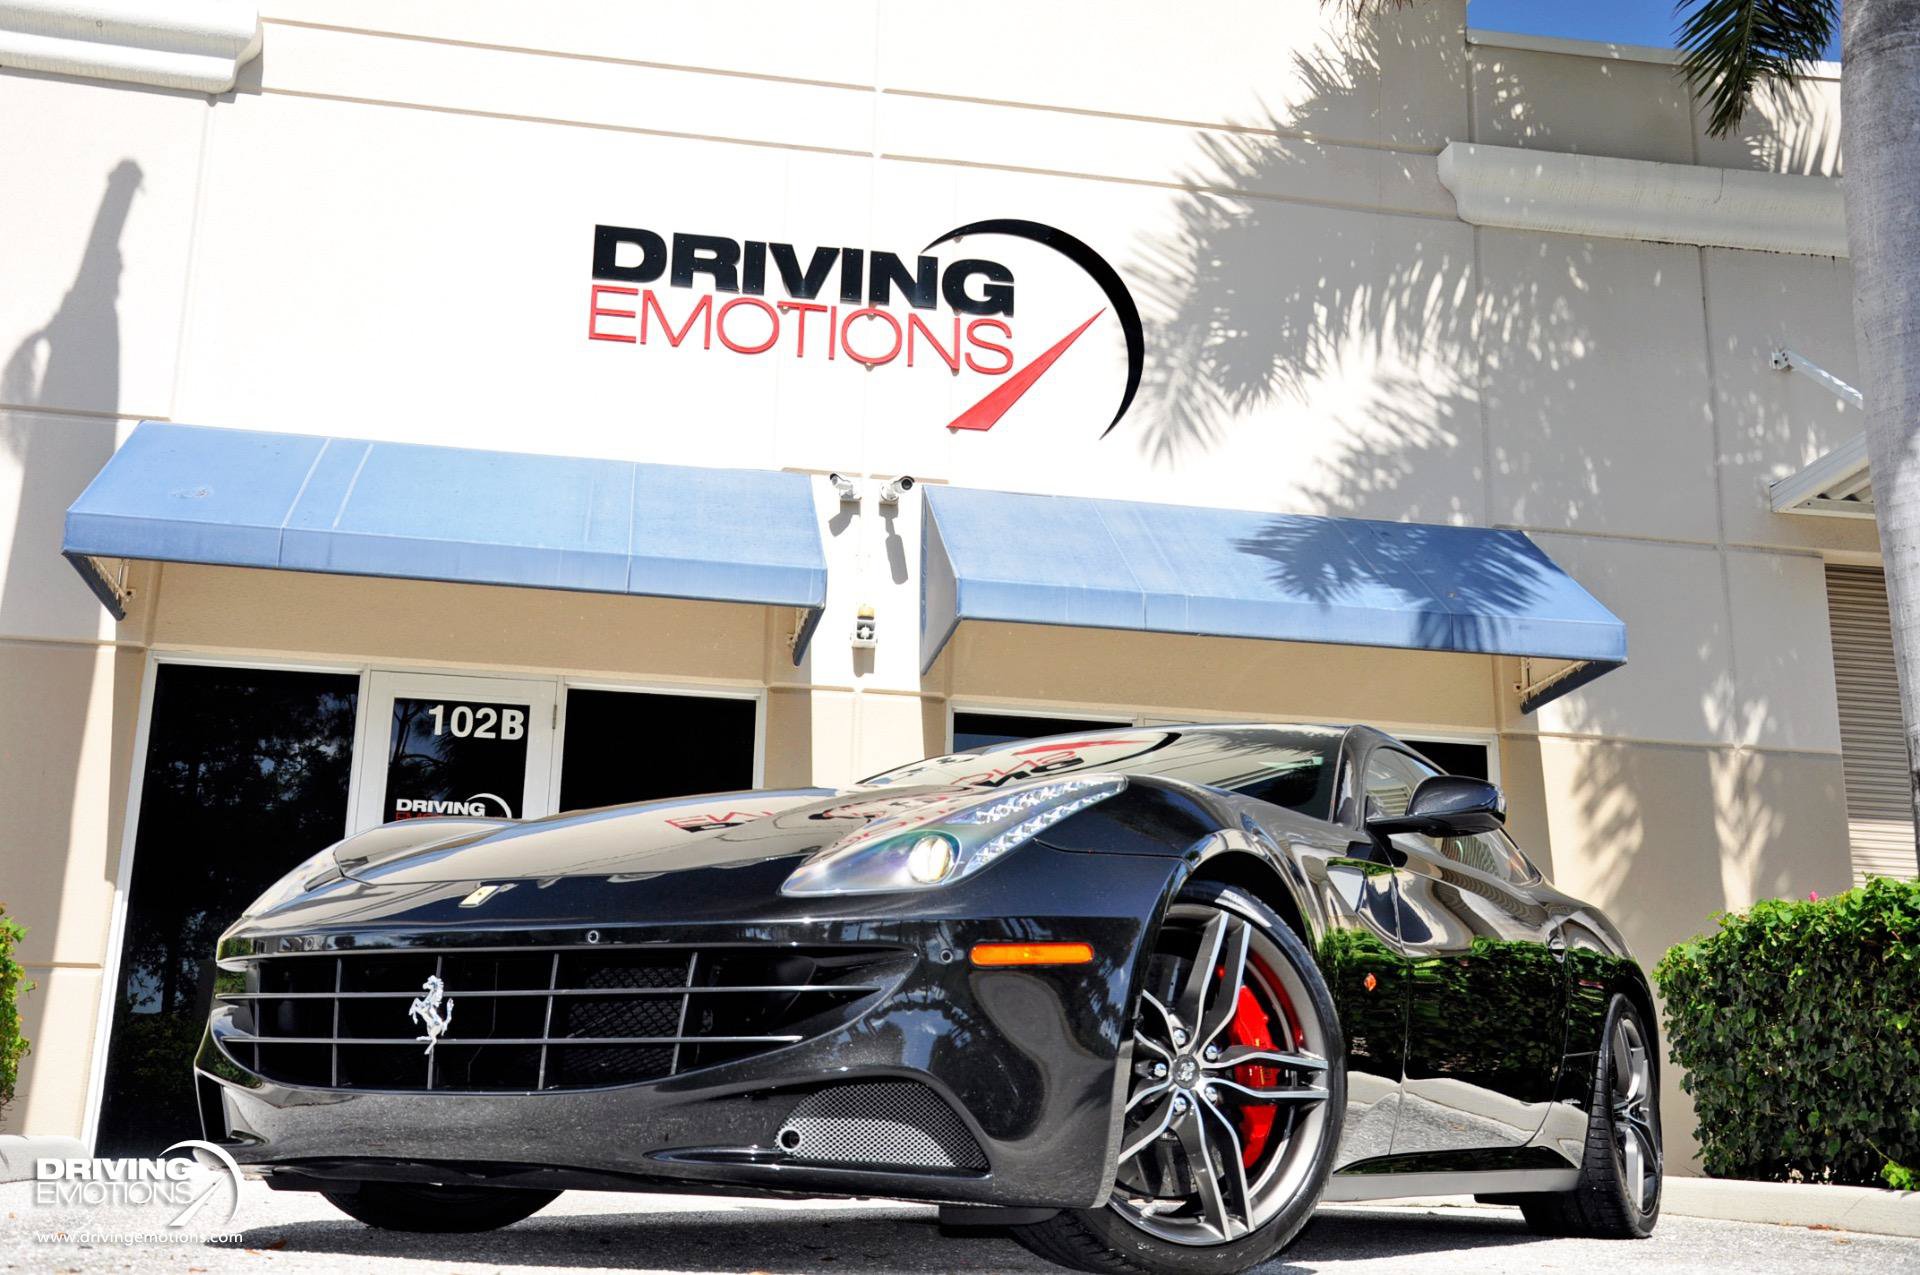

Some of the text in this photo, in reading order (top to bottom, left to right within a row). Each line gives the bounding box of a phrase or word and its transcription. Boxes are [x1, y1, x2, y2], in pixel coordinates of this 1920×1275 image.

[592, 224, 1015, 318] DRIVING
[588, 284, 1014, 375] EMOTIONS
[428, 704, 525, 741] 102B
[395, 798, 486, 817] DRIVING
